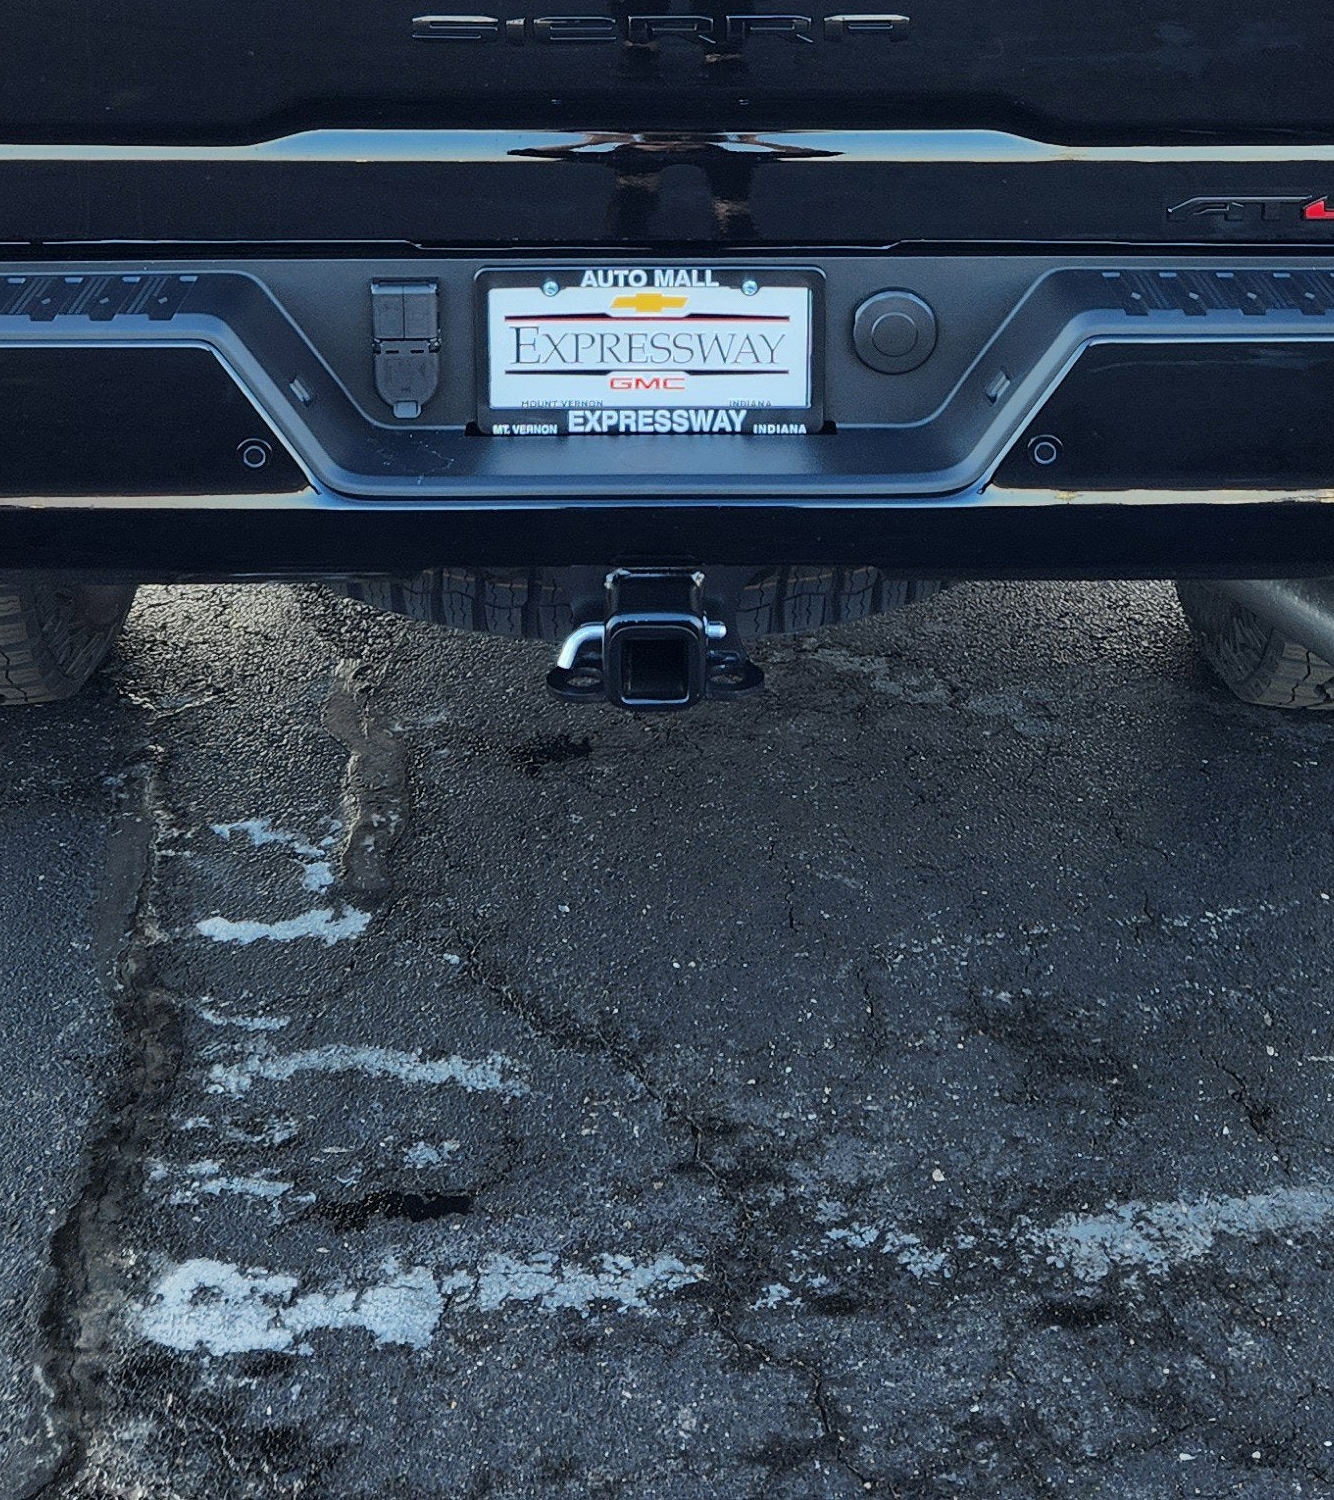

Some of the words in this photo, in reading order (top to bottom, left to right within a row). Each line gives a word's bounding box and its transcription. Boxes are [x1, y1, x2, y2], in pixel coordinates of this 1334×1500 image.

[411, 15, 911, 43] SIERRA
[580, 269, 645, 287] AUTO
[654, 270, 720, 288] MALL
[509, 326, 786, 365] EXPRESSWAY
[610, 377, 686, 390] GMC
[521, 400, 558, 408] MOUNT
[561, 400, 604, 408] VERNON
[729, 400, 772, 408] INDIANA
[568, 410, 747, 433] EXPRESSWAY
[512, 424, 558, 435] VERNON
[753, 424, 807, 435] INDIANA
